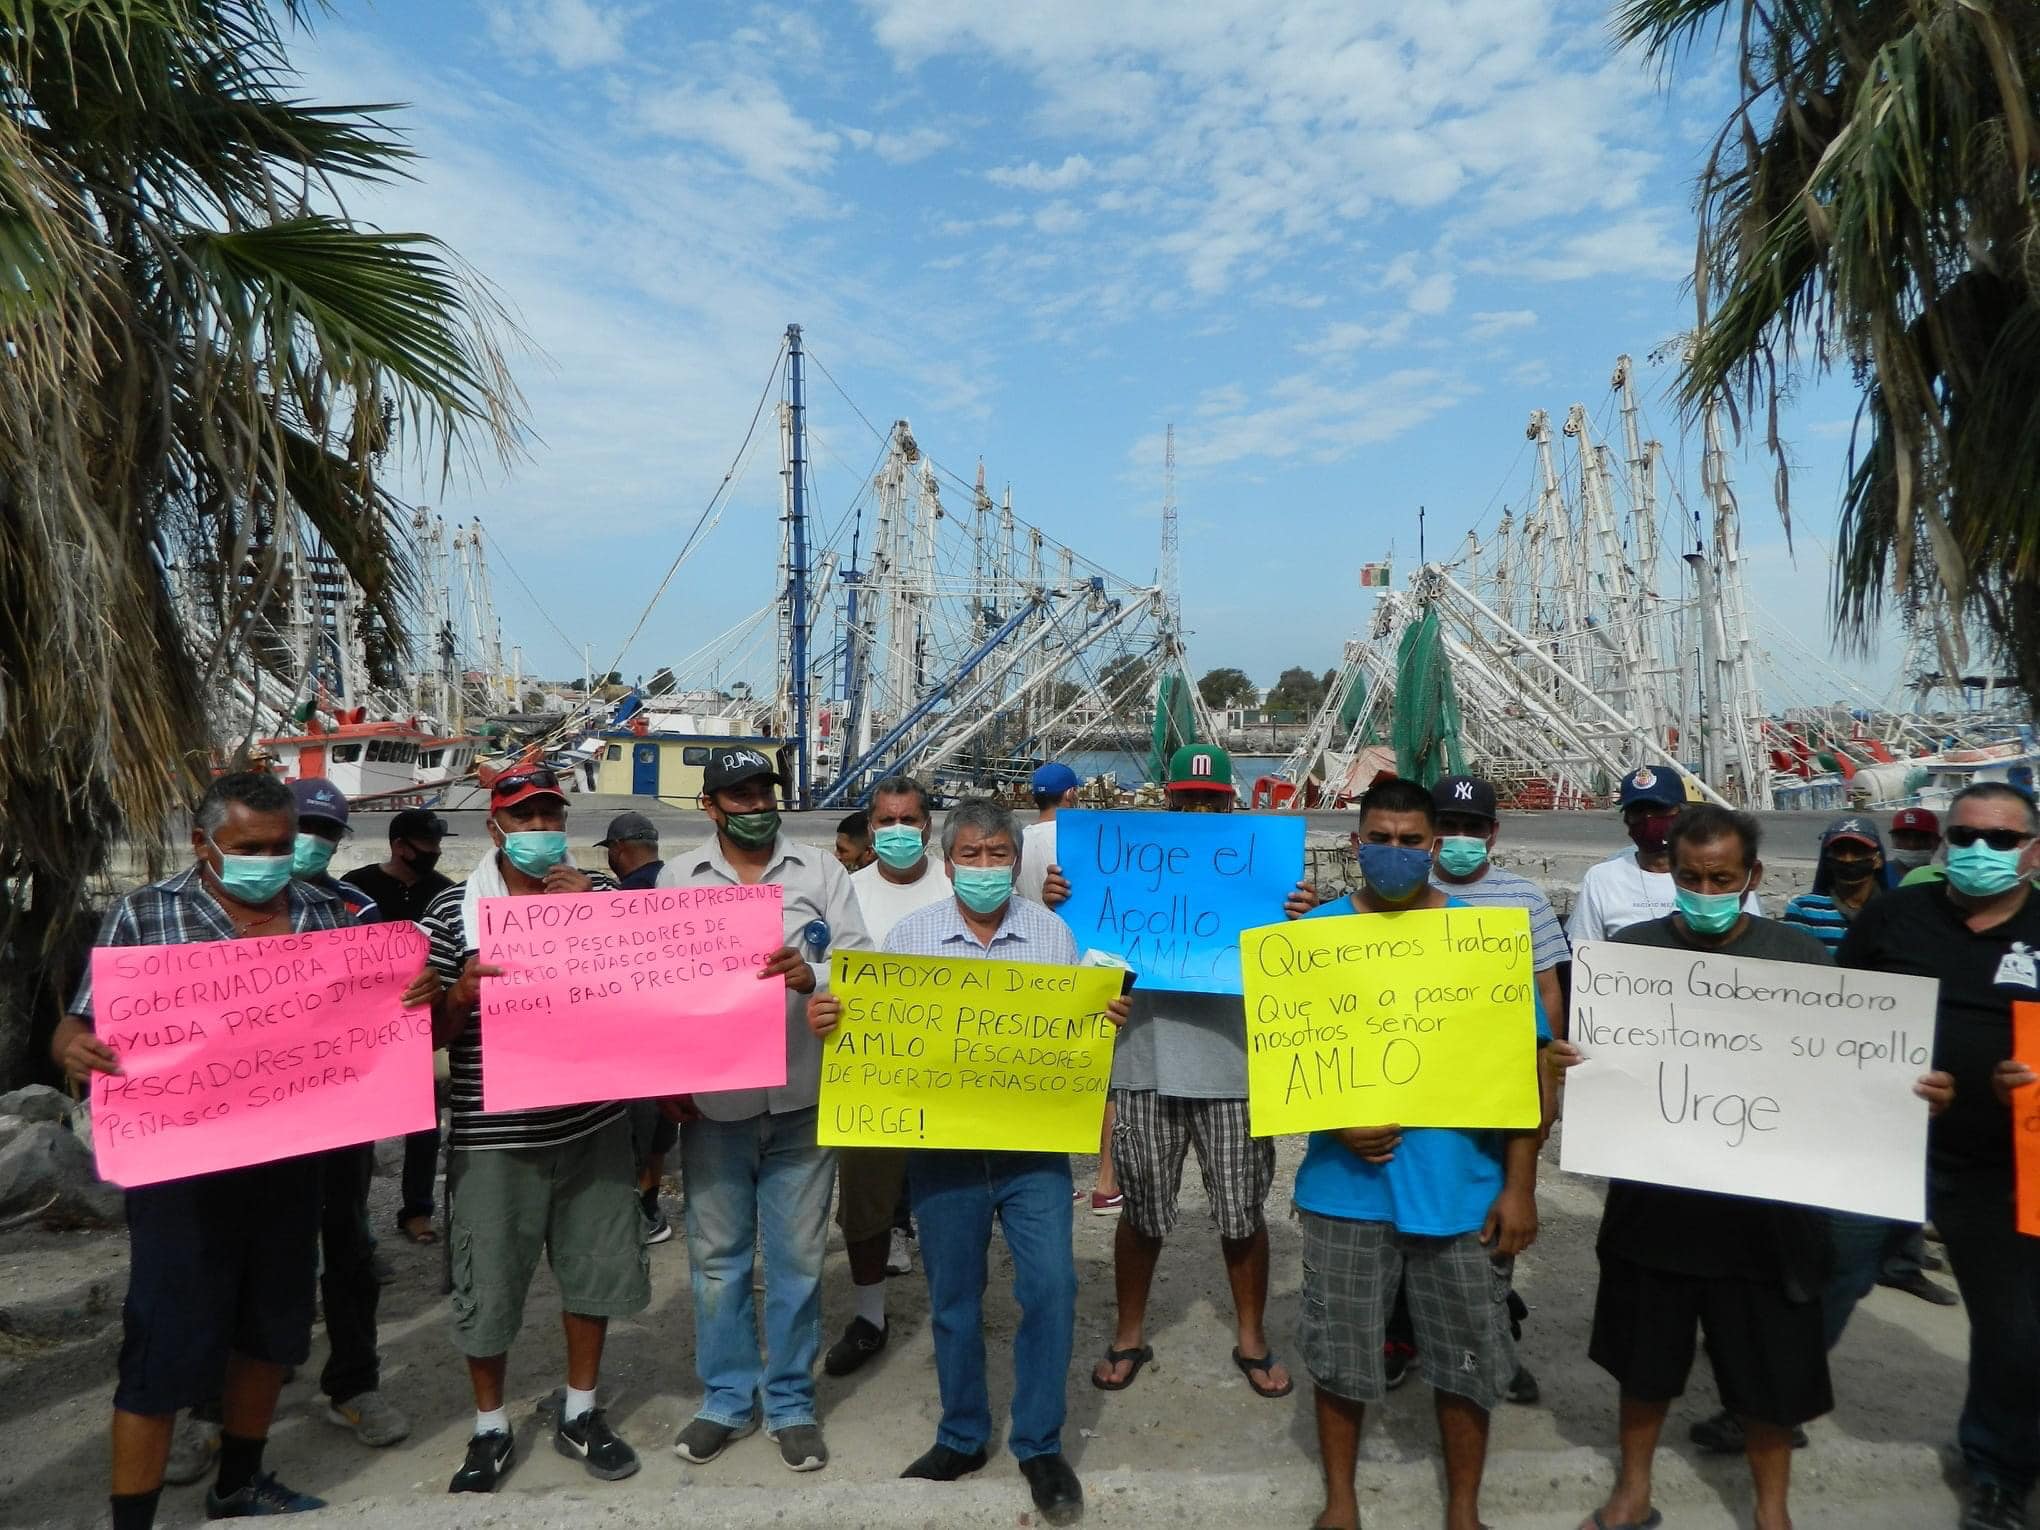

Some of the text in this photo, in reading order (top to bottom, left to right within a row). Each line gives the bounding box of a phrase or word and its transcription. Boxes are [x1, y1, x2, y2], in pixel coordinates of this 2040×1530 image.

[1454, 781, 1473, 800] NY
[1097, 823, 1256, 893] Urge el
[485, 884, 783, 937] ¡APOYO SEÑOR PRESIDENTE
[1096, 885, 1220, 945] Apollo
[328, 927, 356, 945] SU
[489, 917, 728, 960] AMLO PESCADORES DE
[1258, 913, 1530, 978] Queremos trabajo
[491, 934, 743, 987] UERTO PEÑASCO SONORA
[841, 956, 1078, 993] ¡APOYO Al Diecel
[1576, 946, 1673, 997] Señora
[488, 995, 552, 1015] URGE!
[569, 980, 623, 1005] BAJO
[848, 996, 1112, 1040] SEÑOR PRESIDENTE
[1257, 983, 1531, 1024] Que va a pasar con
[104, 1020, 208, 1051] AYUDA
[835, 1032, 1093, 1070] AMLO PESCADORES
[1254, 1013, 1448, 1053] nosotros señor
[1577, 1002, 1928, 1070] Necesitamos su apollo
[98, 1012, 432, 1106] PESCADORES DE PUERTO
[826, 1063, 851, 1084] DE
[863, 1063, 952, 1089] PUERTO
[959, 1069, 1066, 1092] PEÑASCO
[1285, 1037, 1421, 1105] AMLO
[101, 1065, 360, 1148] PEÑASCO SONORA
[835, 1104, 925, 1139] URGE!
[1658, 1061, 1781, 1148] Urge
